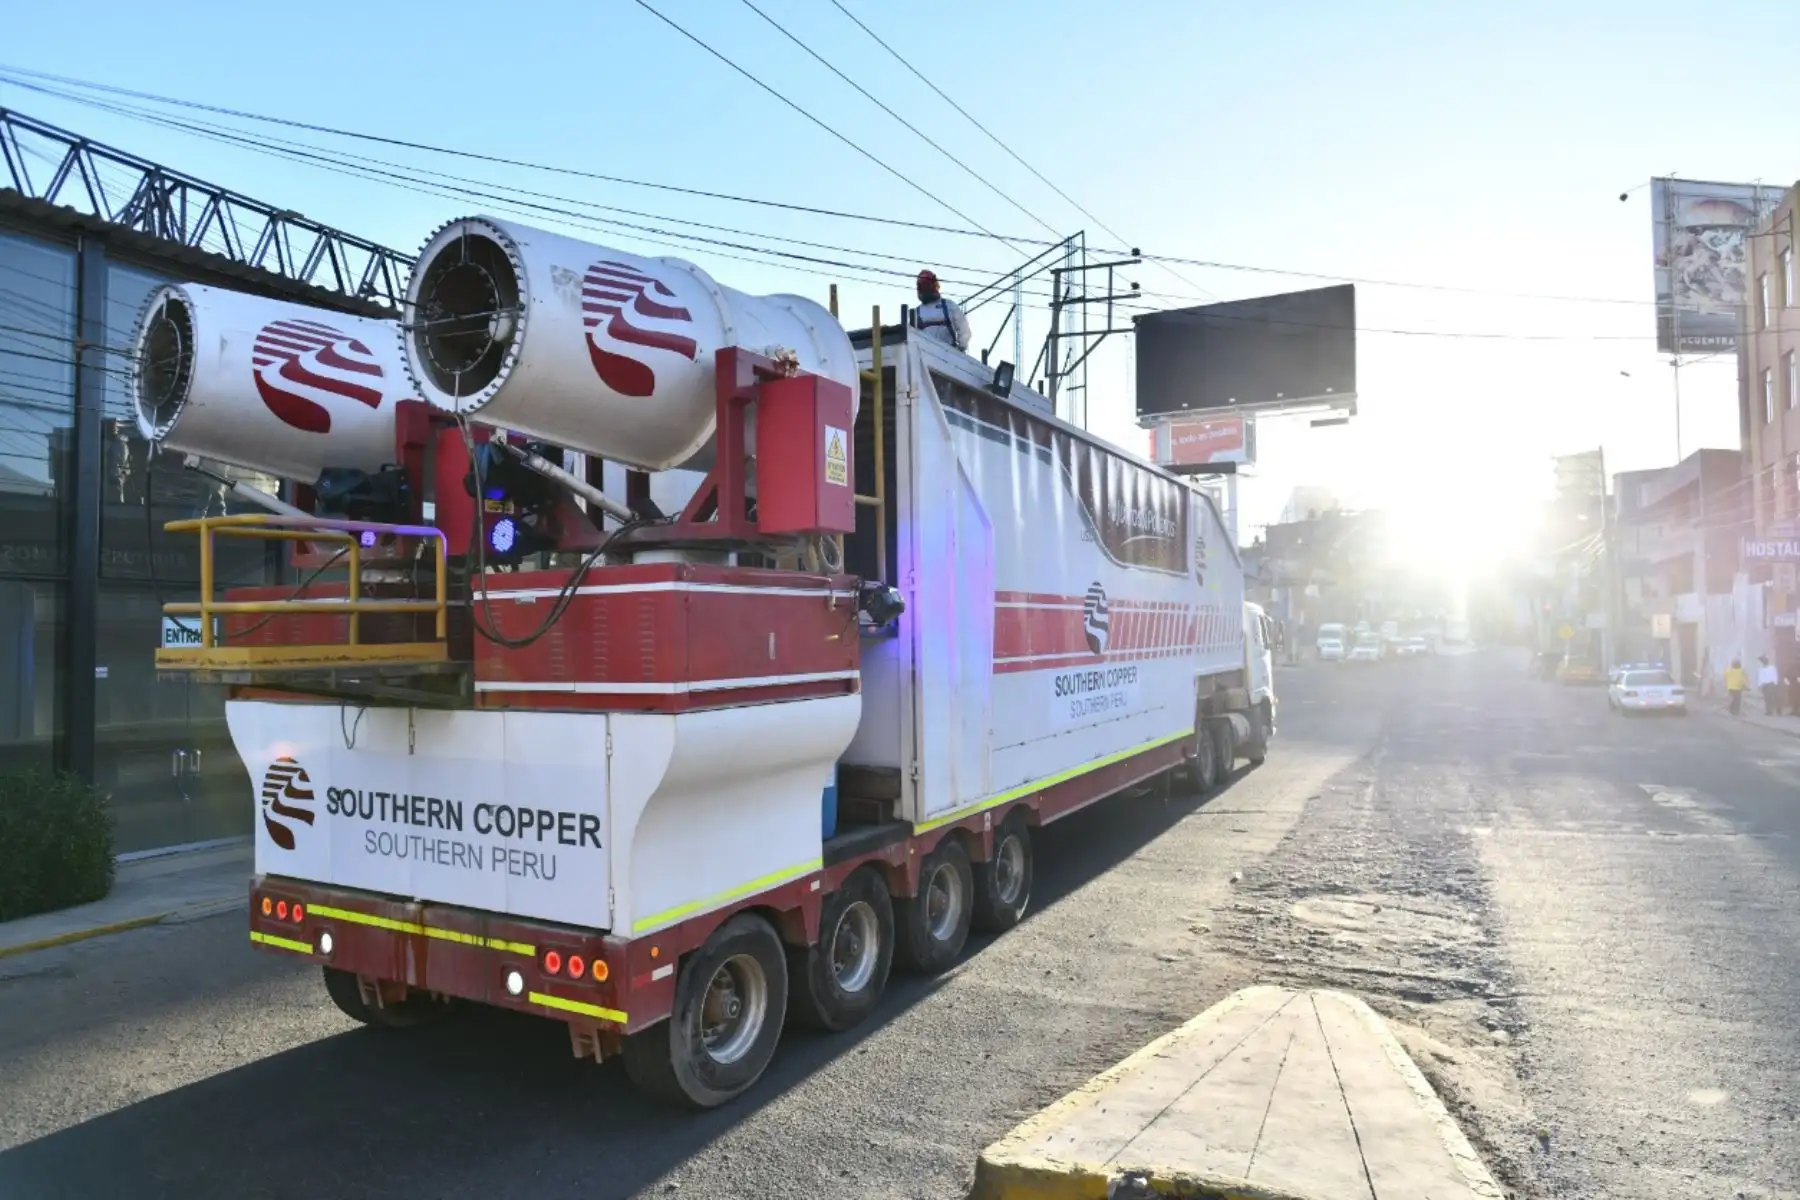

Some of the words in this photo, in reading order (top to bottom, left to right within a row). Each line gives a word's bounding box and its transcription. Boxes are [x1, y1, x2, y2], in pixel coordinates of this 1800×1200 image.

[1746, 541, 1800, 557] HOSTAL
[166, 628, 203, 644] ENTRA
[1055, 670, 1105, 697] SOUTHERN
[1107, 666, 1137, 689] COPPER
[1070, 695, 1109, 719] SOUTHERN
[1111, 691, 1127, 709] PERU
[326, 786, 463, 832] SOUTHERN
[473, 803, 602, 848] COPPER
[365, 831, 483, 870] SOUTHERN
[493, 847, 557, 881] PERU
